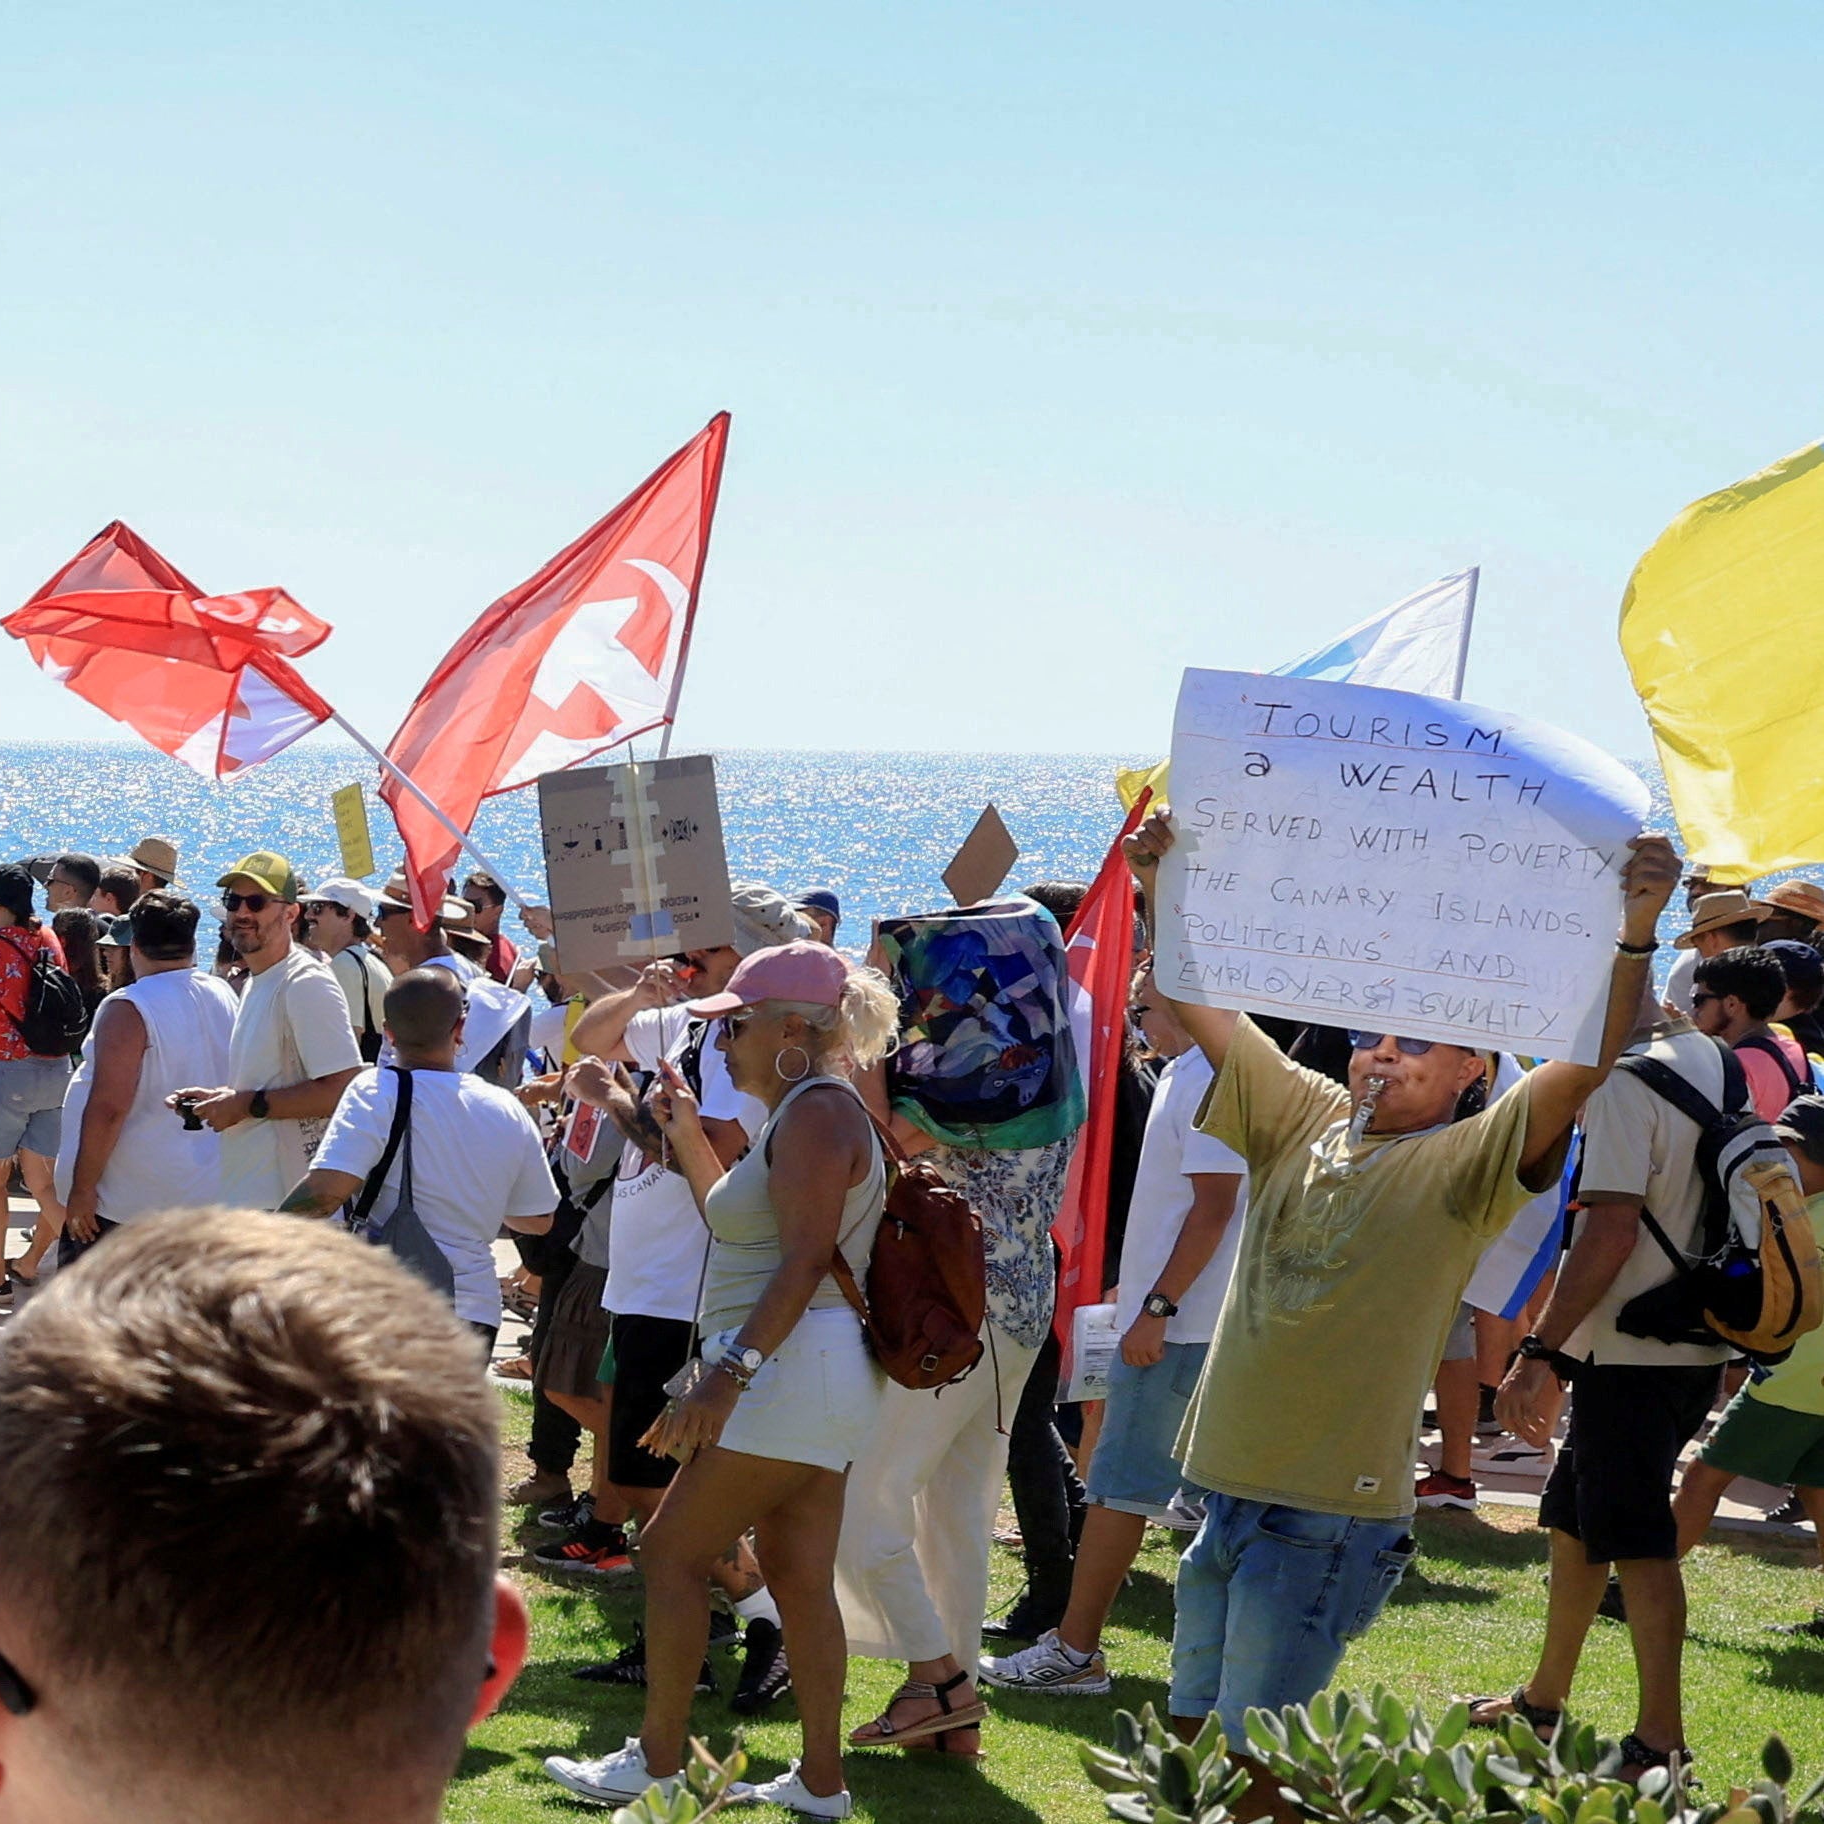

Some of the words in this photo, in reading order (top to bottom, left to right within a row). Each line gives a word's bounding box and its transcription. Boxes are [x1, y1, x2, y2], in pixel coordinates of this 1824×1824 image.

[1244, 752, 1270, 776] a
[1340, 762, 1546, 805] WEALTH
[1191, 798, 1322, 839] SERVED
[1350, 826, 1428, 852] WITH
[1459, 833, 1615, 879] POVERTY
[673, 913, 693, 924] PESO
[1271, 877, 1395, 915] CANARY
[1434, 892, 1591, 937] ISLANDS.
[1435, 950, 1515, 978] AND
[629, 1166, 667, 1196] CANAR
